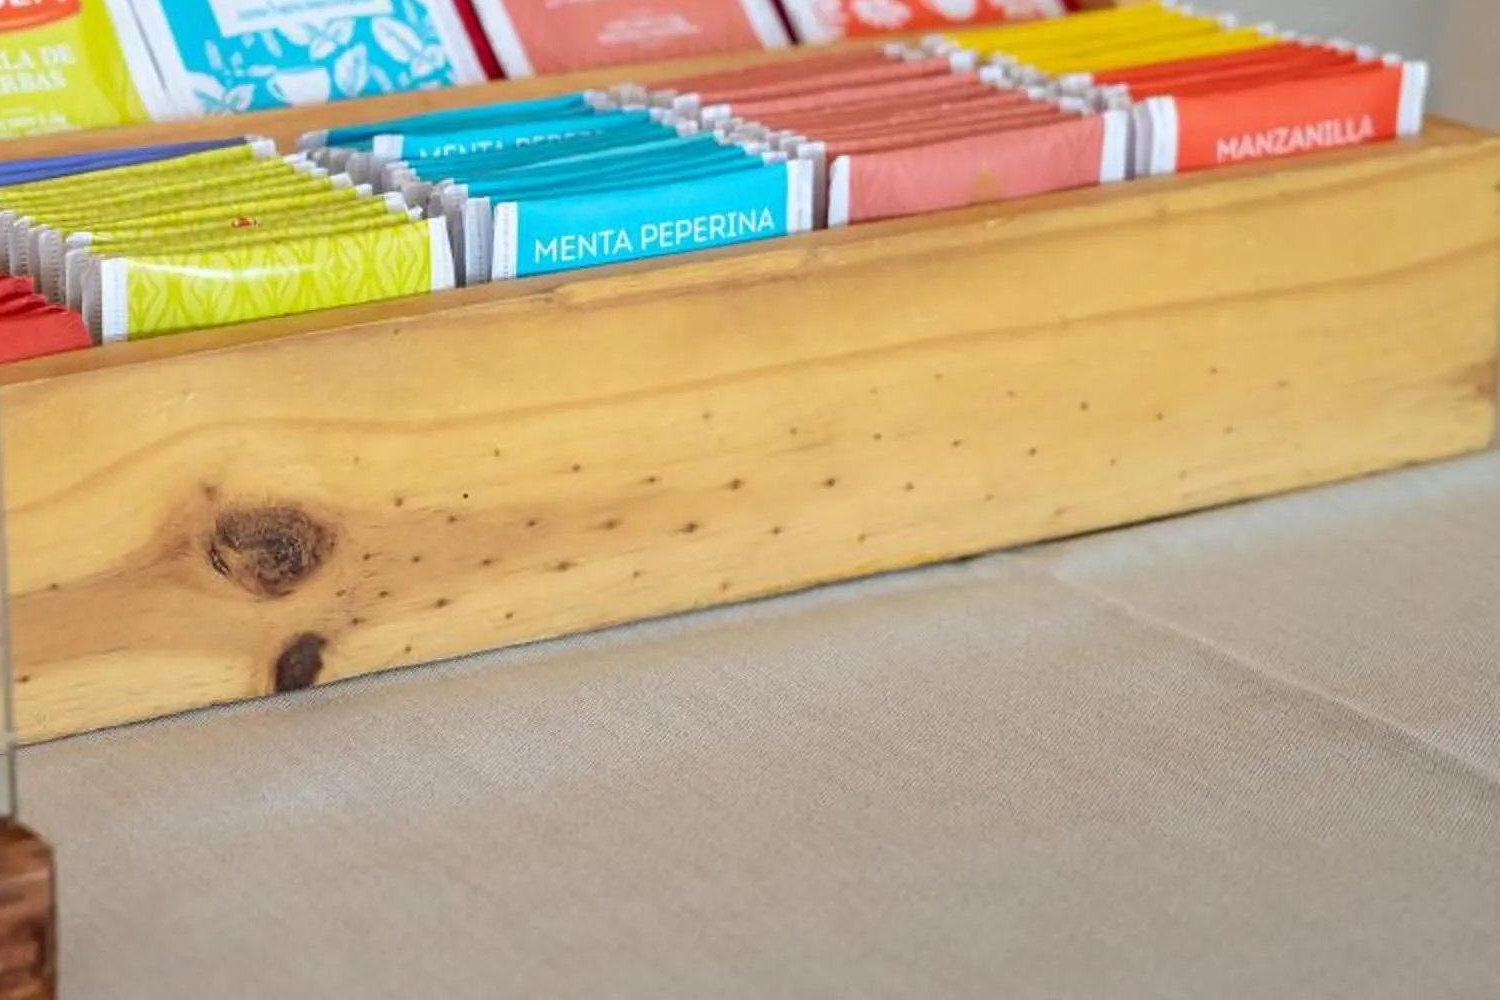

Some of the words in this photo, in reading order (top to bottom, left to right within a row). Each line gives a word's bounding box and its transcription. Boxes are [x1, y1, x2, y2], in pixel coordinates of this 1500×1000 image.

[41, 46, 76, 65] DE
[1216, 115, 1375, 164] MANZANILLA
[534, 229, 633, 264] MENTA
[639, 207, 775, 250] PEPERINA
